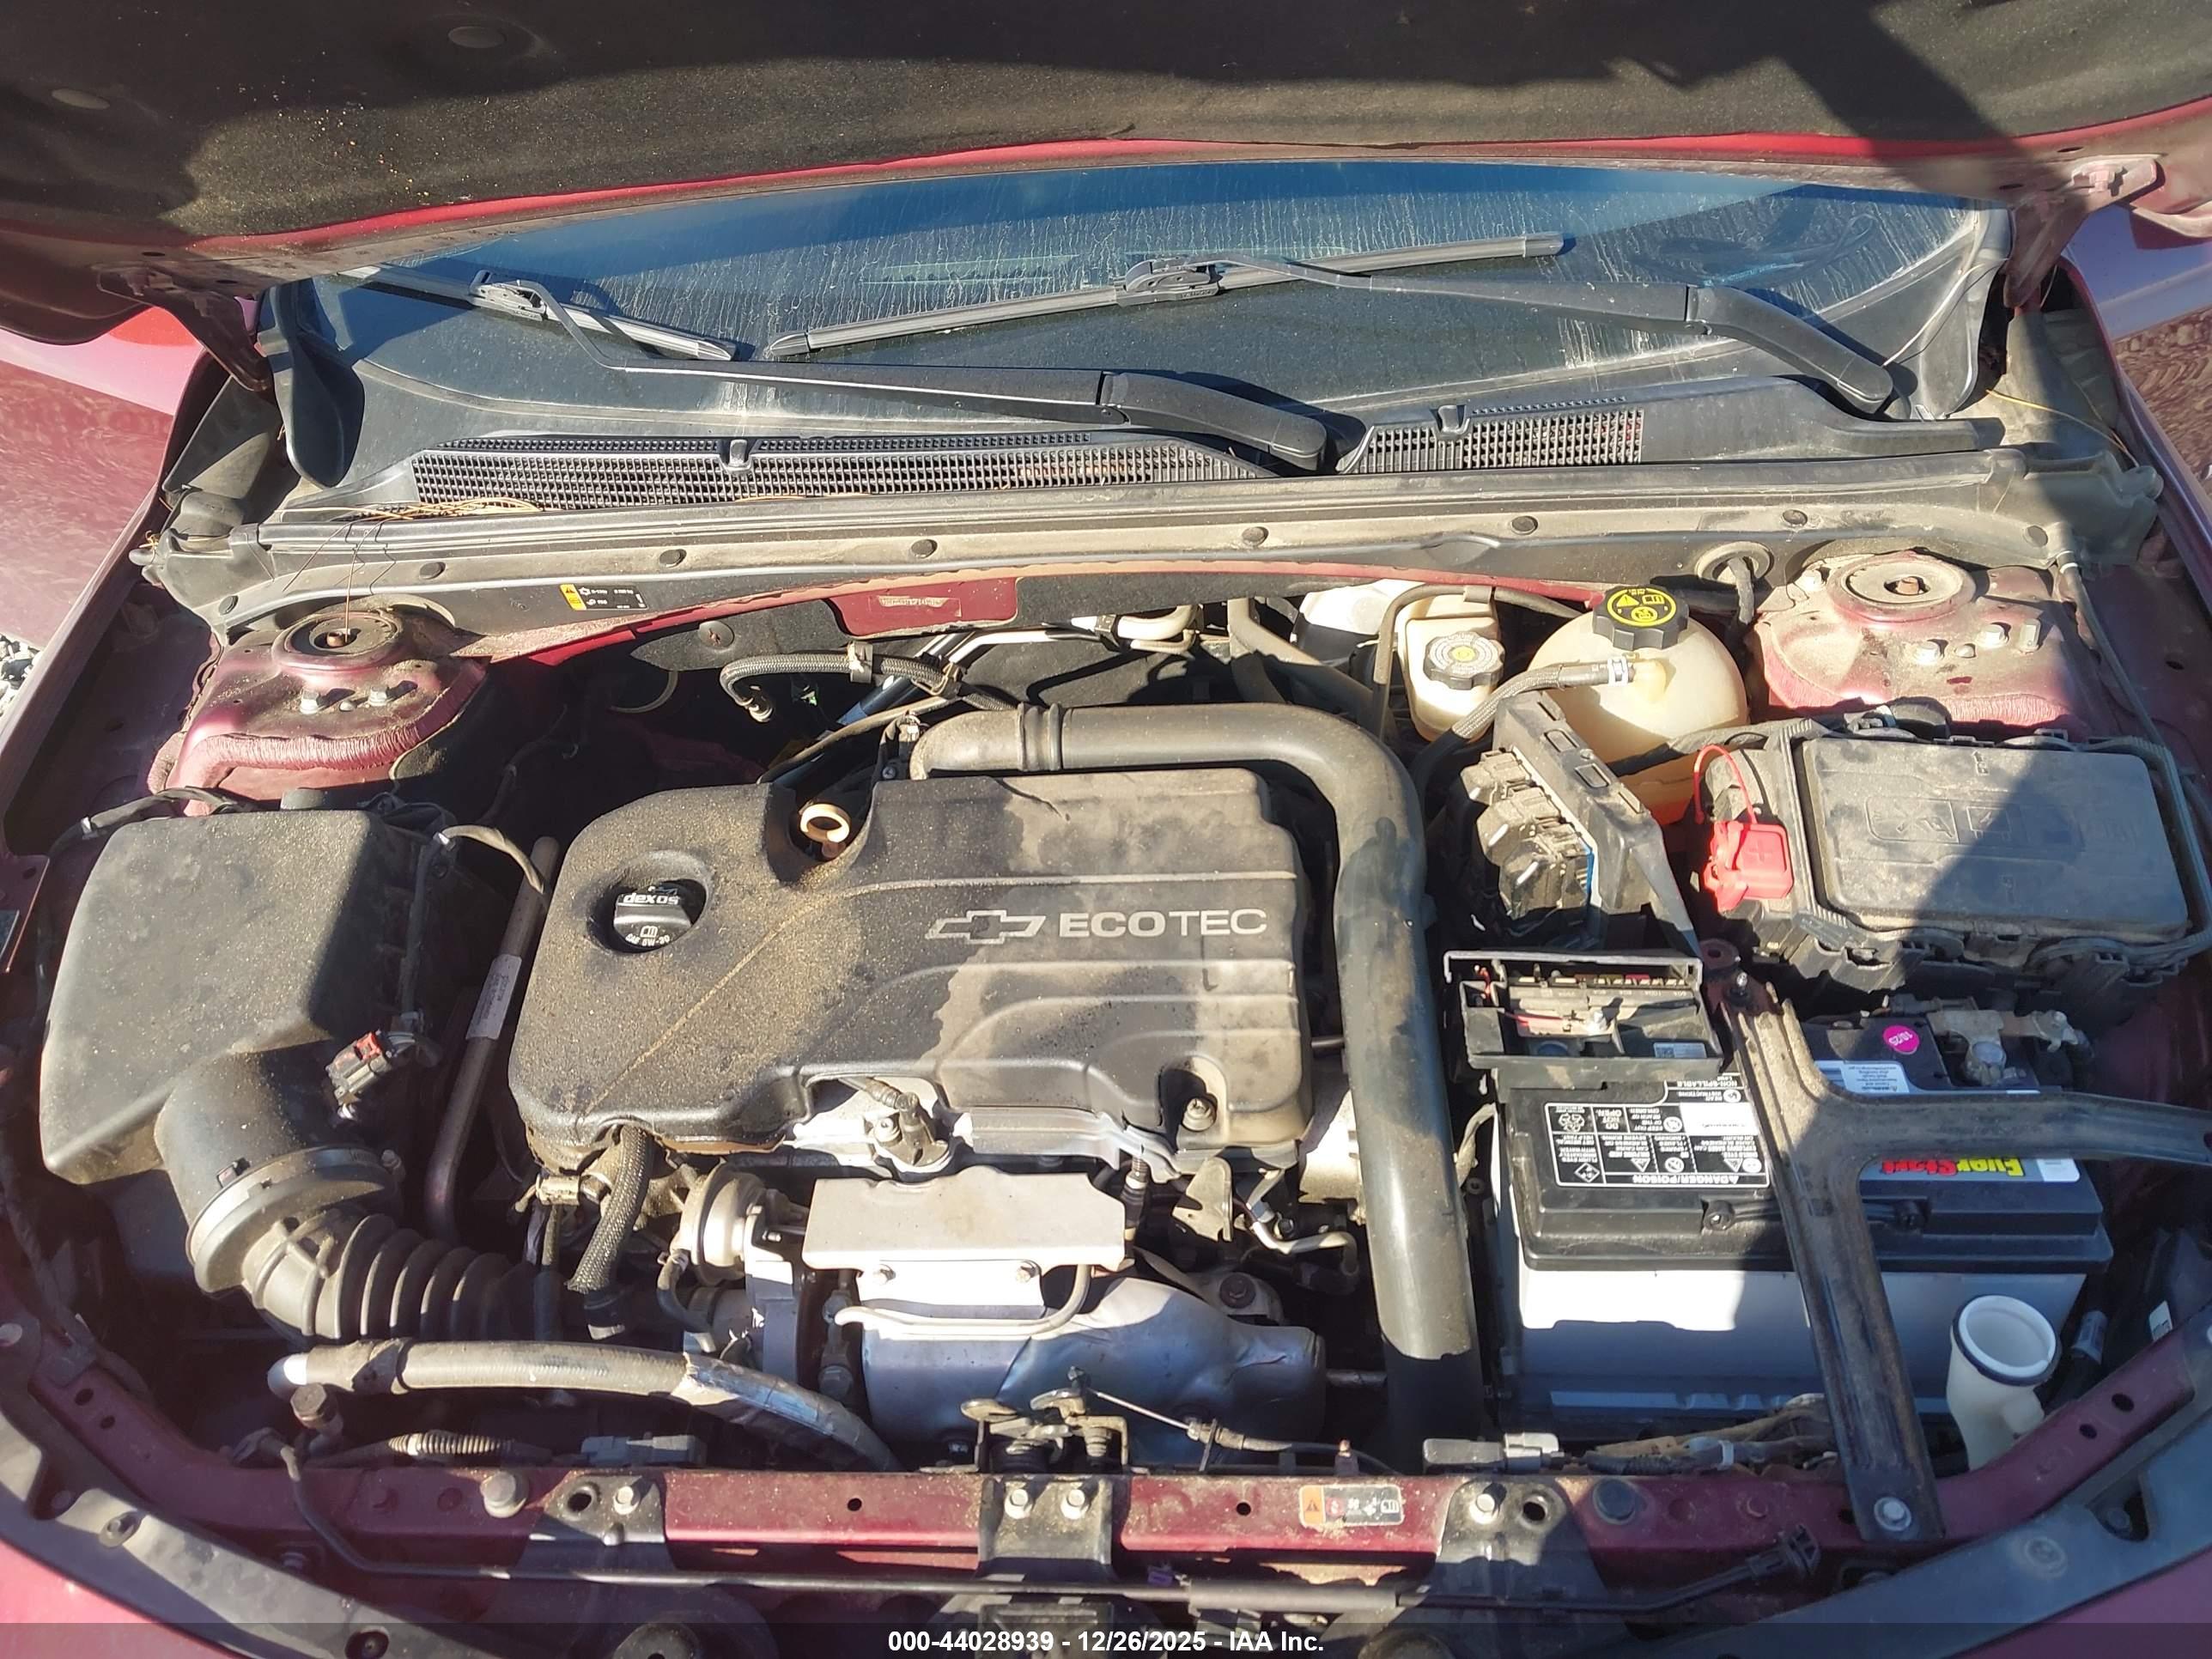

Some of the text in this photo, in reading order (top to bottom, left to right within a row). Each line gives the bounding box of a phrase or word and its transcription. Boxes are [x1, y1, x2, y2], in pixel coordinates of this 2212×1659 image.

[623, 893, 679, 905] dexos
[1059, 908, 1267, 938] ECOTEC
[1632, 1175, 1729, 1184] DANGER/POISON
